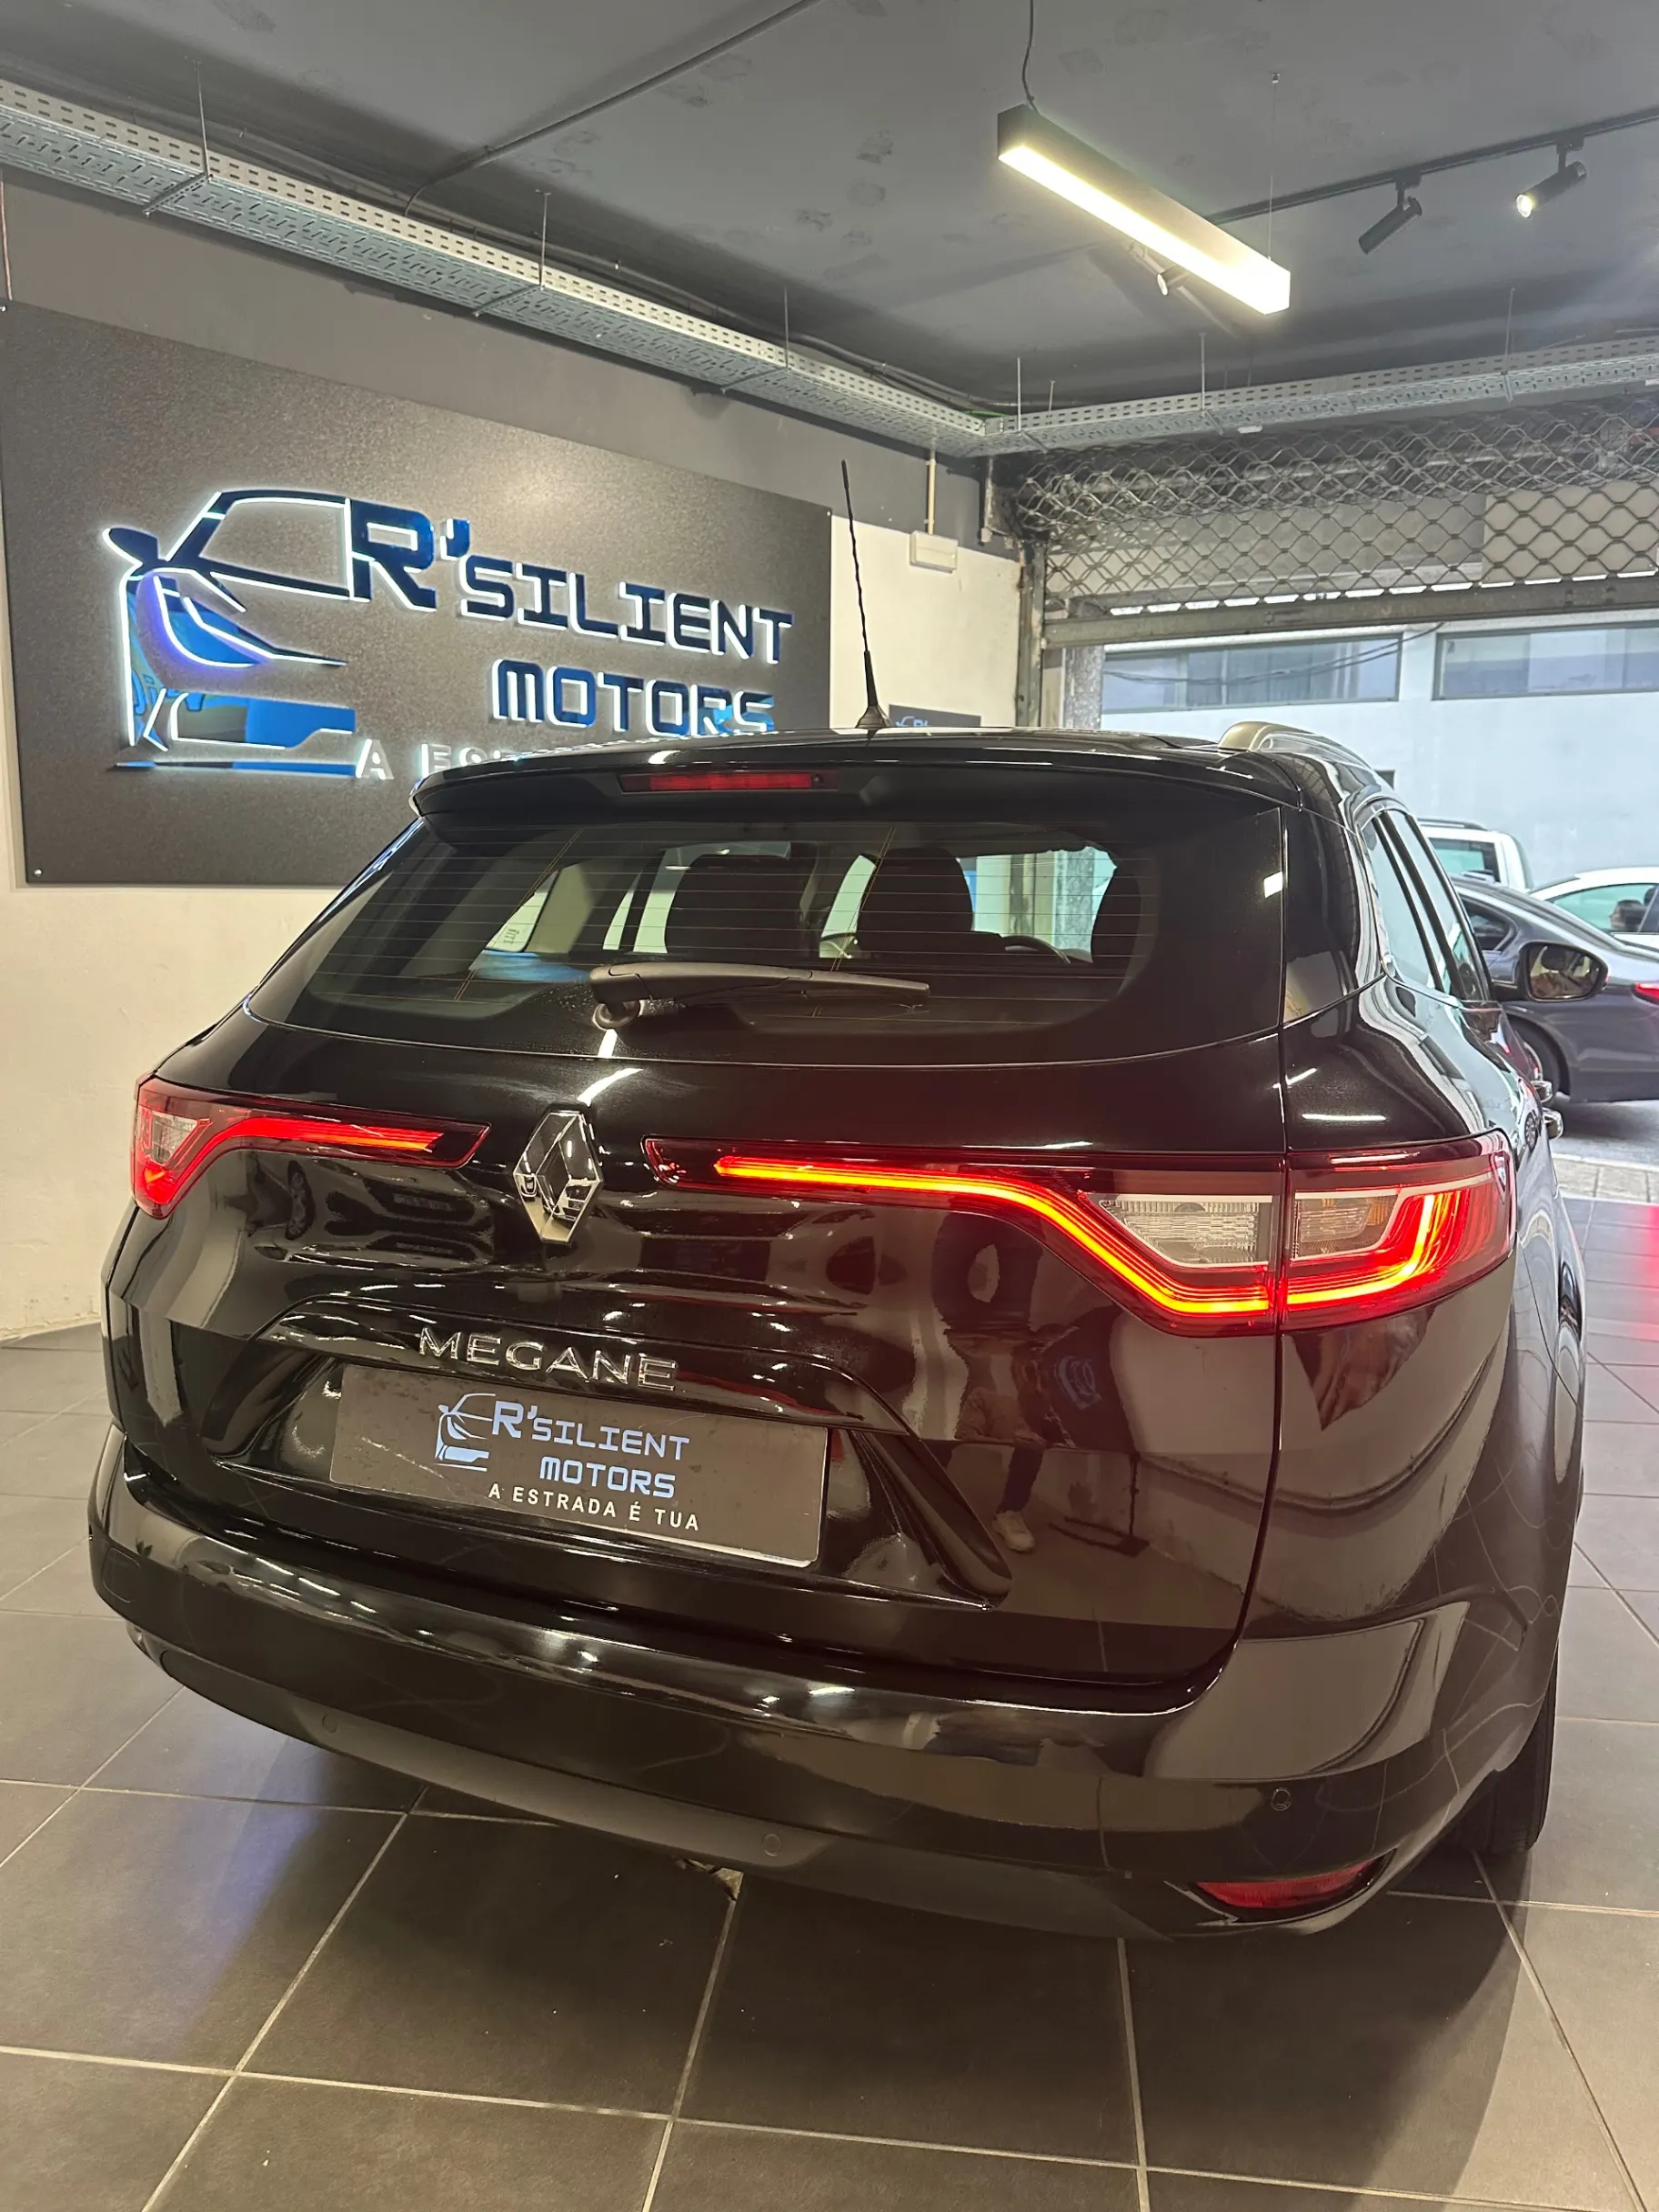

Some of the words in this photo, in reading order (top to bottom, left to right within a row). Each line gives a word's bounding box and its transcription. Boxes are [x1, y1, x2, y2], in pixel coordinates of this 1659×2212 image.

[347, 498, 793, 664] R'SILIENT
[492, 659, 773, 736] MOTORS
[356, 738, 395, 780] A
[419, 1327, 677, 1392] MEGANE
[492, 1401, 689, 1460] R'SILIENT
[539, 1456, 676, 1498] MOTORS
[488, 1482, 501, 1501] A
[511, 1486, 618, 1519] ESTRADA
[628, 1500, 642, 1523] É
[653, 1508, 699, 1532] TUA
